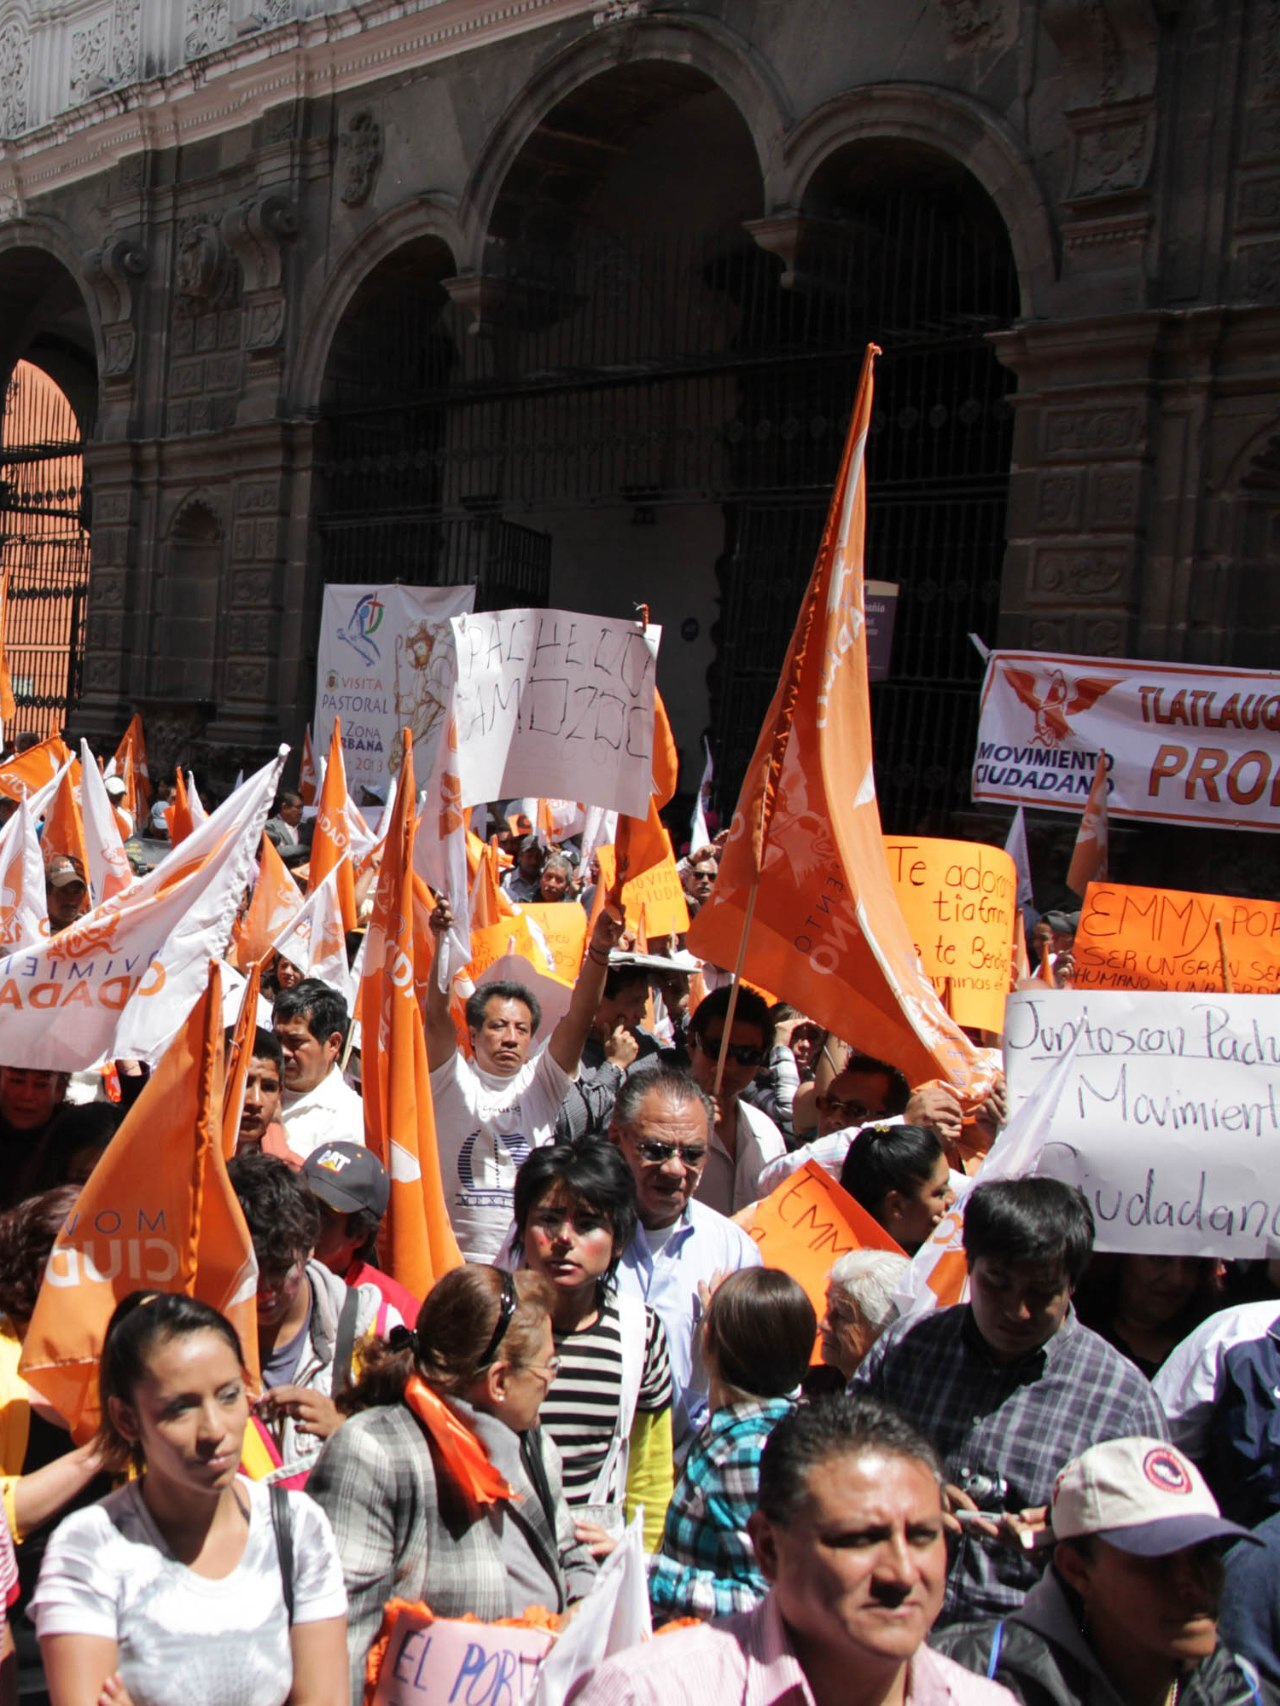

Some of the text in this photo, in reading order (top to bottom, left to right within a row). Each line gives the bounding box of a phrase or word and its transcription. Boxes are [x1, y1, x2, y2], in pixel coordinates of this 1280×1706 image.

[341, 677, 384, 691] VISITA
[321, 694, 389, 714] PASTORAL
[345, 721, 381, 739] ZONA
[977, 742, 1115, 772] MOVIMIENTO
[1148, 744, 1280, 807] PRO
[887, 846, 927, 887] Te
[1082, 891, 1216, 959] EMMY
[1081, 946, 1137, 972] SER
[1074, 967, 1151, 990] HUMANO
[317, 1150, 352, 1173] CAT
[392, 1629, 433, 1692] EL
